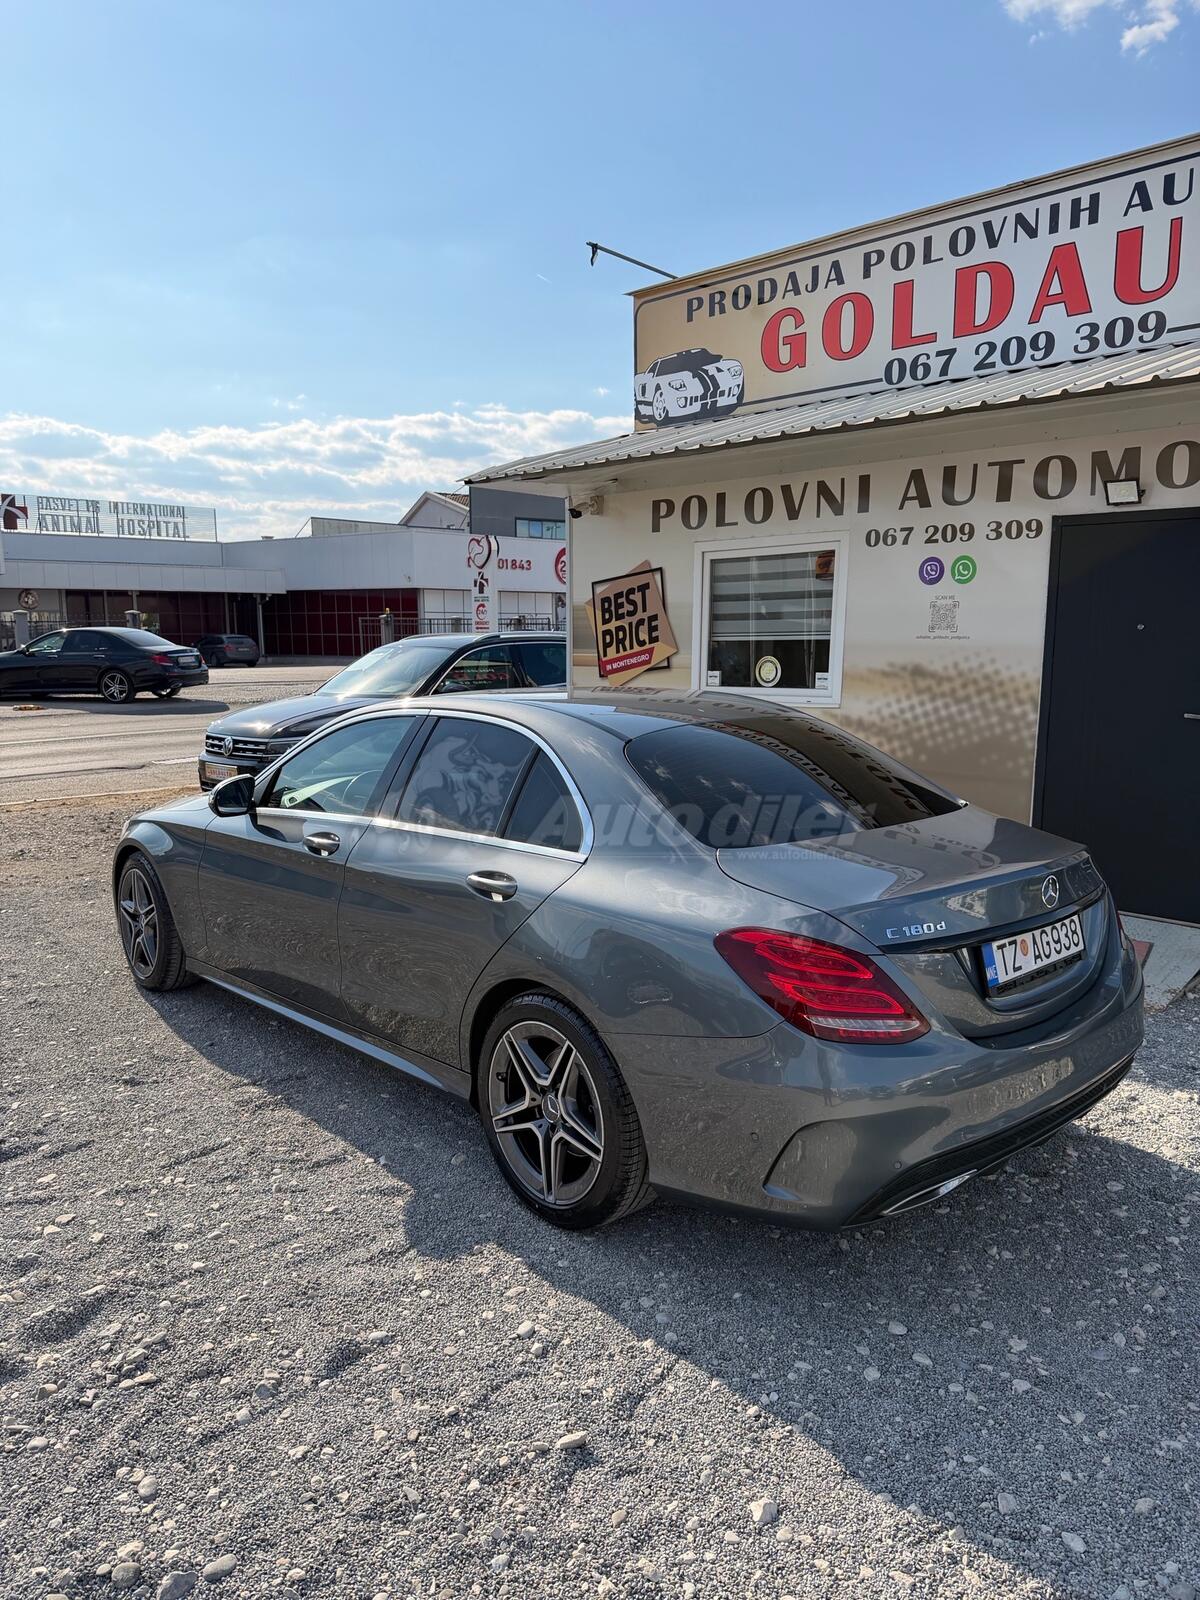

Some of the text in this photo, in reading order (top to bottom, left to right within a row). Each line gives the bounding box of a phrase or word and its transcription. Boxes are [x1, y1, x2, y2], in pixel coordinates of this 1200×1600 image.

[686, 168, 1194, 322] PRODAJA POLOVNIH AU
[760, 216, 1183, 373] GOLDAU
[883, 310, 1167, 386] 067 209 309
[108, 500, 188, 518] INTERNATIONAL
[651, 474, 871, 533] POLOVNI
[40, 513, 190, 539] ANIMAL HOSPITAL
[865, 518, 1043, 547] 067 209 309
[600, 582, 650, 625] BEST
[602, 614, 659, 657] PRICE
[612, 653, 650, 669] MONTENEGRO
[996, 918, 1080, 976] TZ AG938
